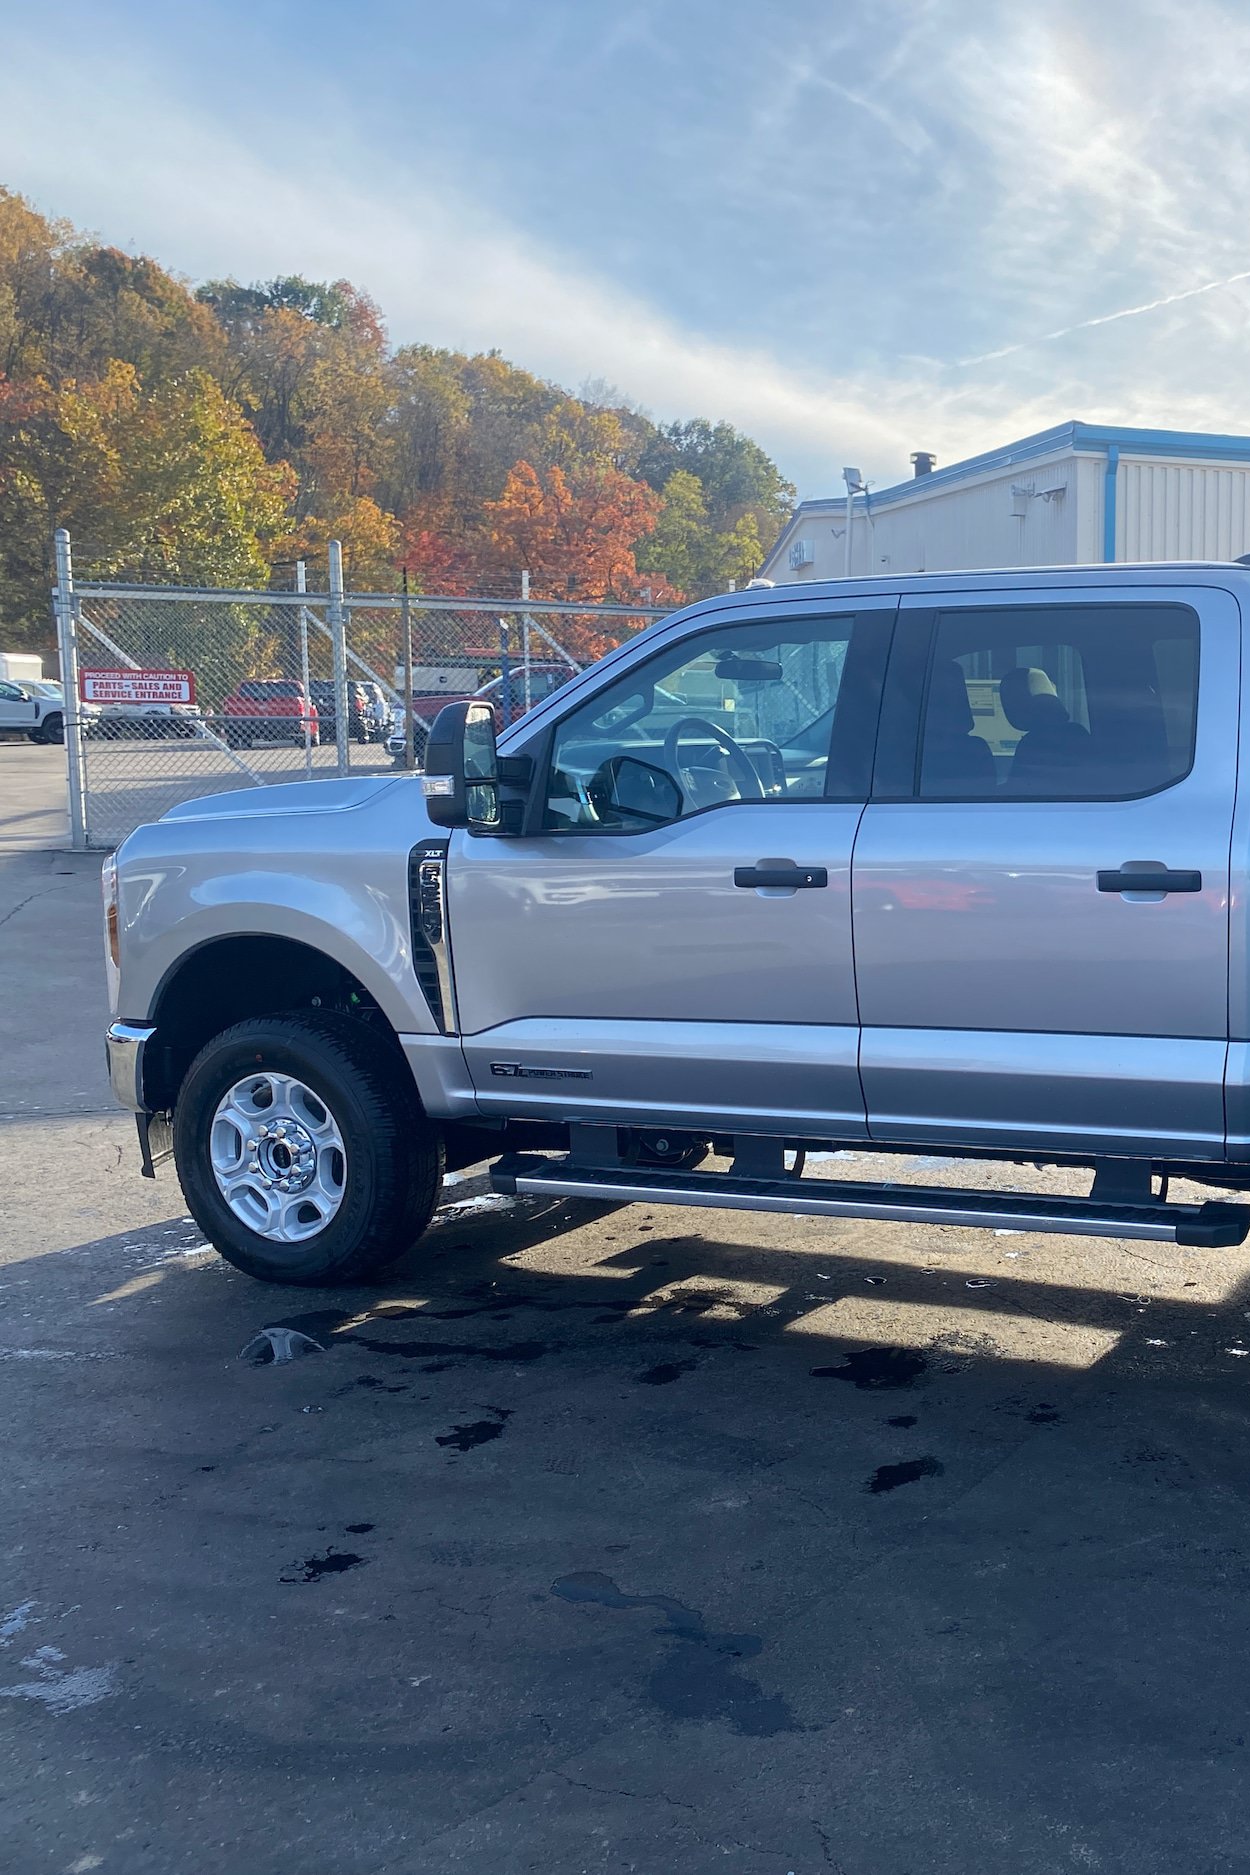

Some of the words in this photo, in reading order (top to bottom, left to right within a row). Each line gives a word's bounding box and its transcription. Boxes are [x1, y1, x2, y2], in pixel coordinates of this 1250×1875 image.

[142, 673, 176, 681] CAUTION
[162, 683, 182, 691] AND
[93, 690, 132, 698] SERVICE
[135, 691, 182, 699] ENTRANCE
